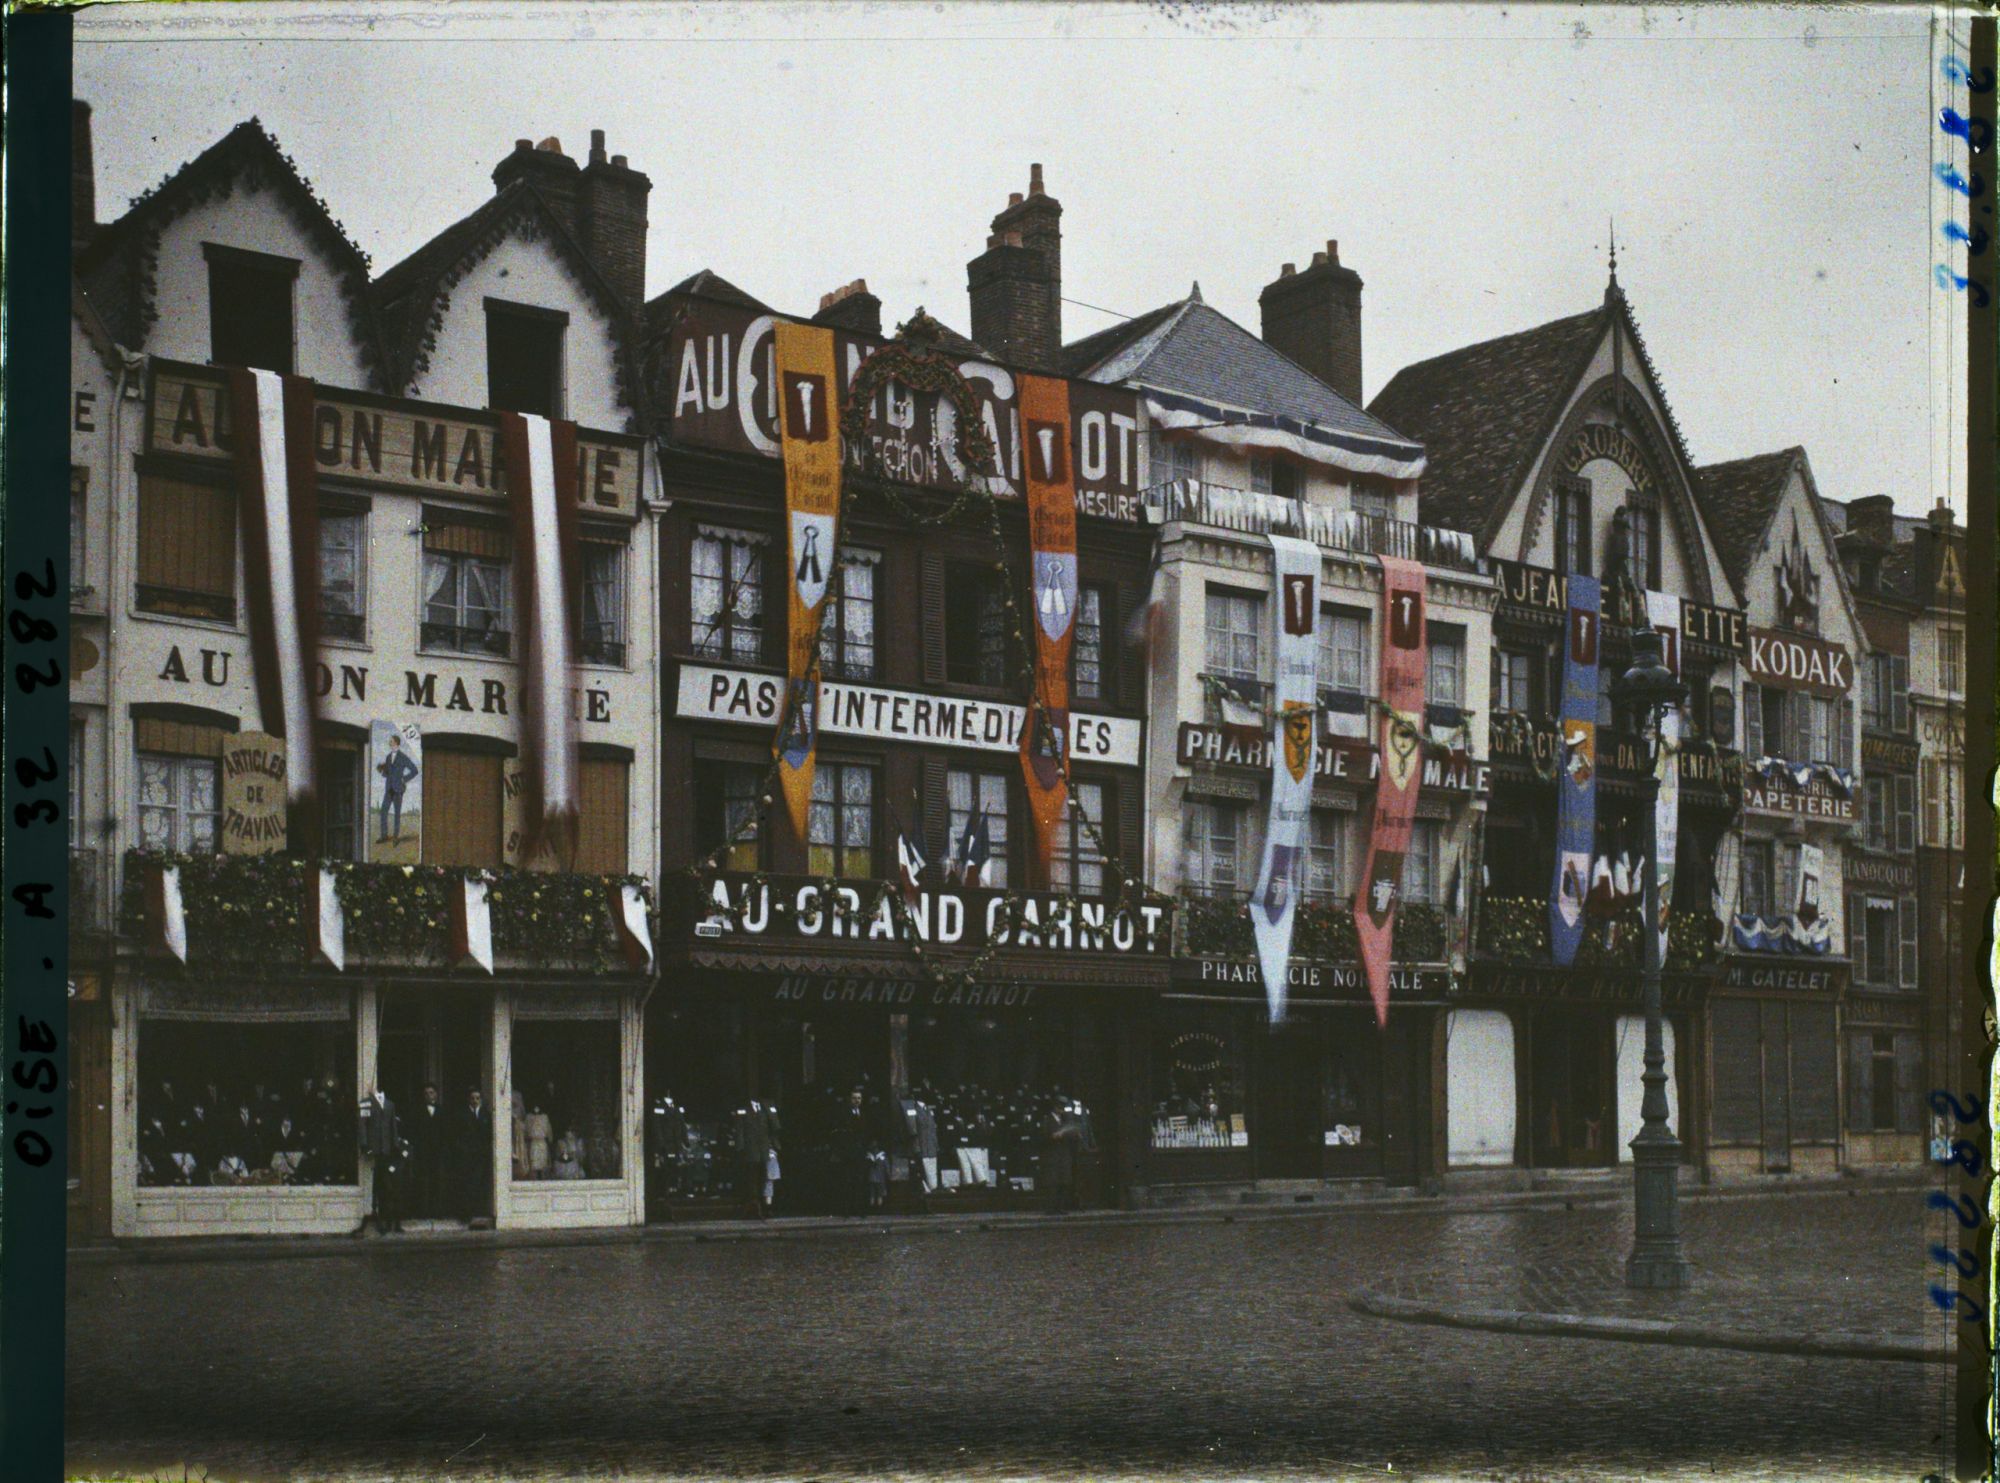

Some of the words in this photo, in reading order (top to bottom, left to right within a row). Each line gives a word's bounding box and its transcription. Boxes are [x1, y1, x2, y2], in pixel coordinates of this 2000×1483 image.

[674, 334, 730, 419] AU
[158, 645, 232, 687] AU
[1751, 635, 1847, 688] KODAK
[709, 673, 777, 719] PAS
[223, 748, 287, 782] ARTICLES
[1186, 729, 1350, 777] PHARCIE
[246, 785, 264, 803] DE
[222, 806, 287, 841] TRAVAIL
[704, 878, 769, 936] AU
[796, 884, 966, 945] GRAND
[986, 894, 1163, 953] CARNOT
[773, 978, 809, 1001] AU
[822, 979, 916, 1005] GRAND
[931, 984, 1038, 1007] CARNOT
[1201, 960, 1321, 987] PHARCIE
[1751, 970, 1833, 991] GATELET
